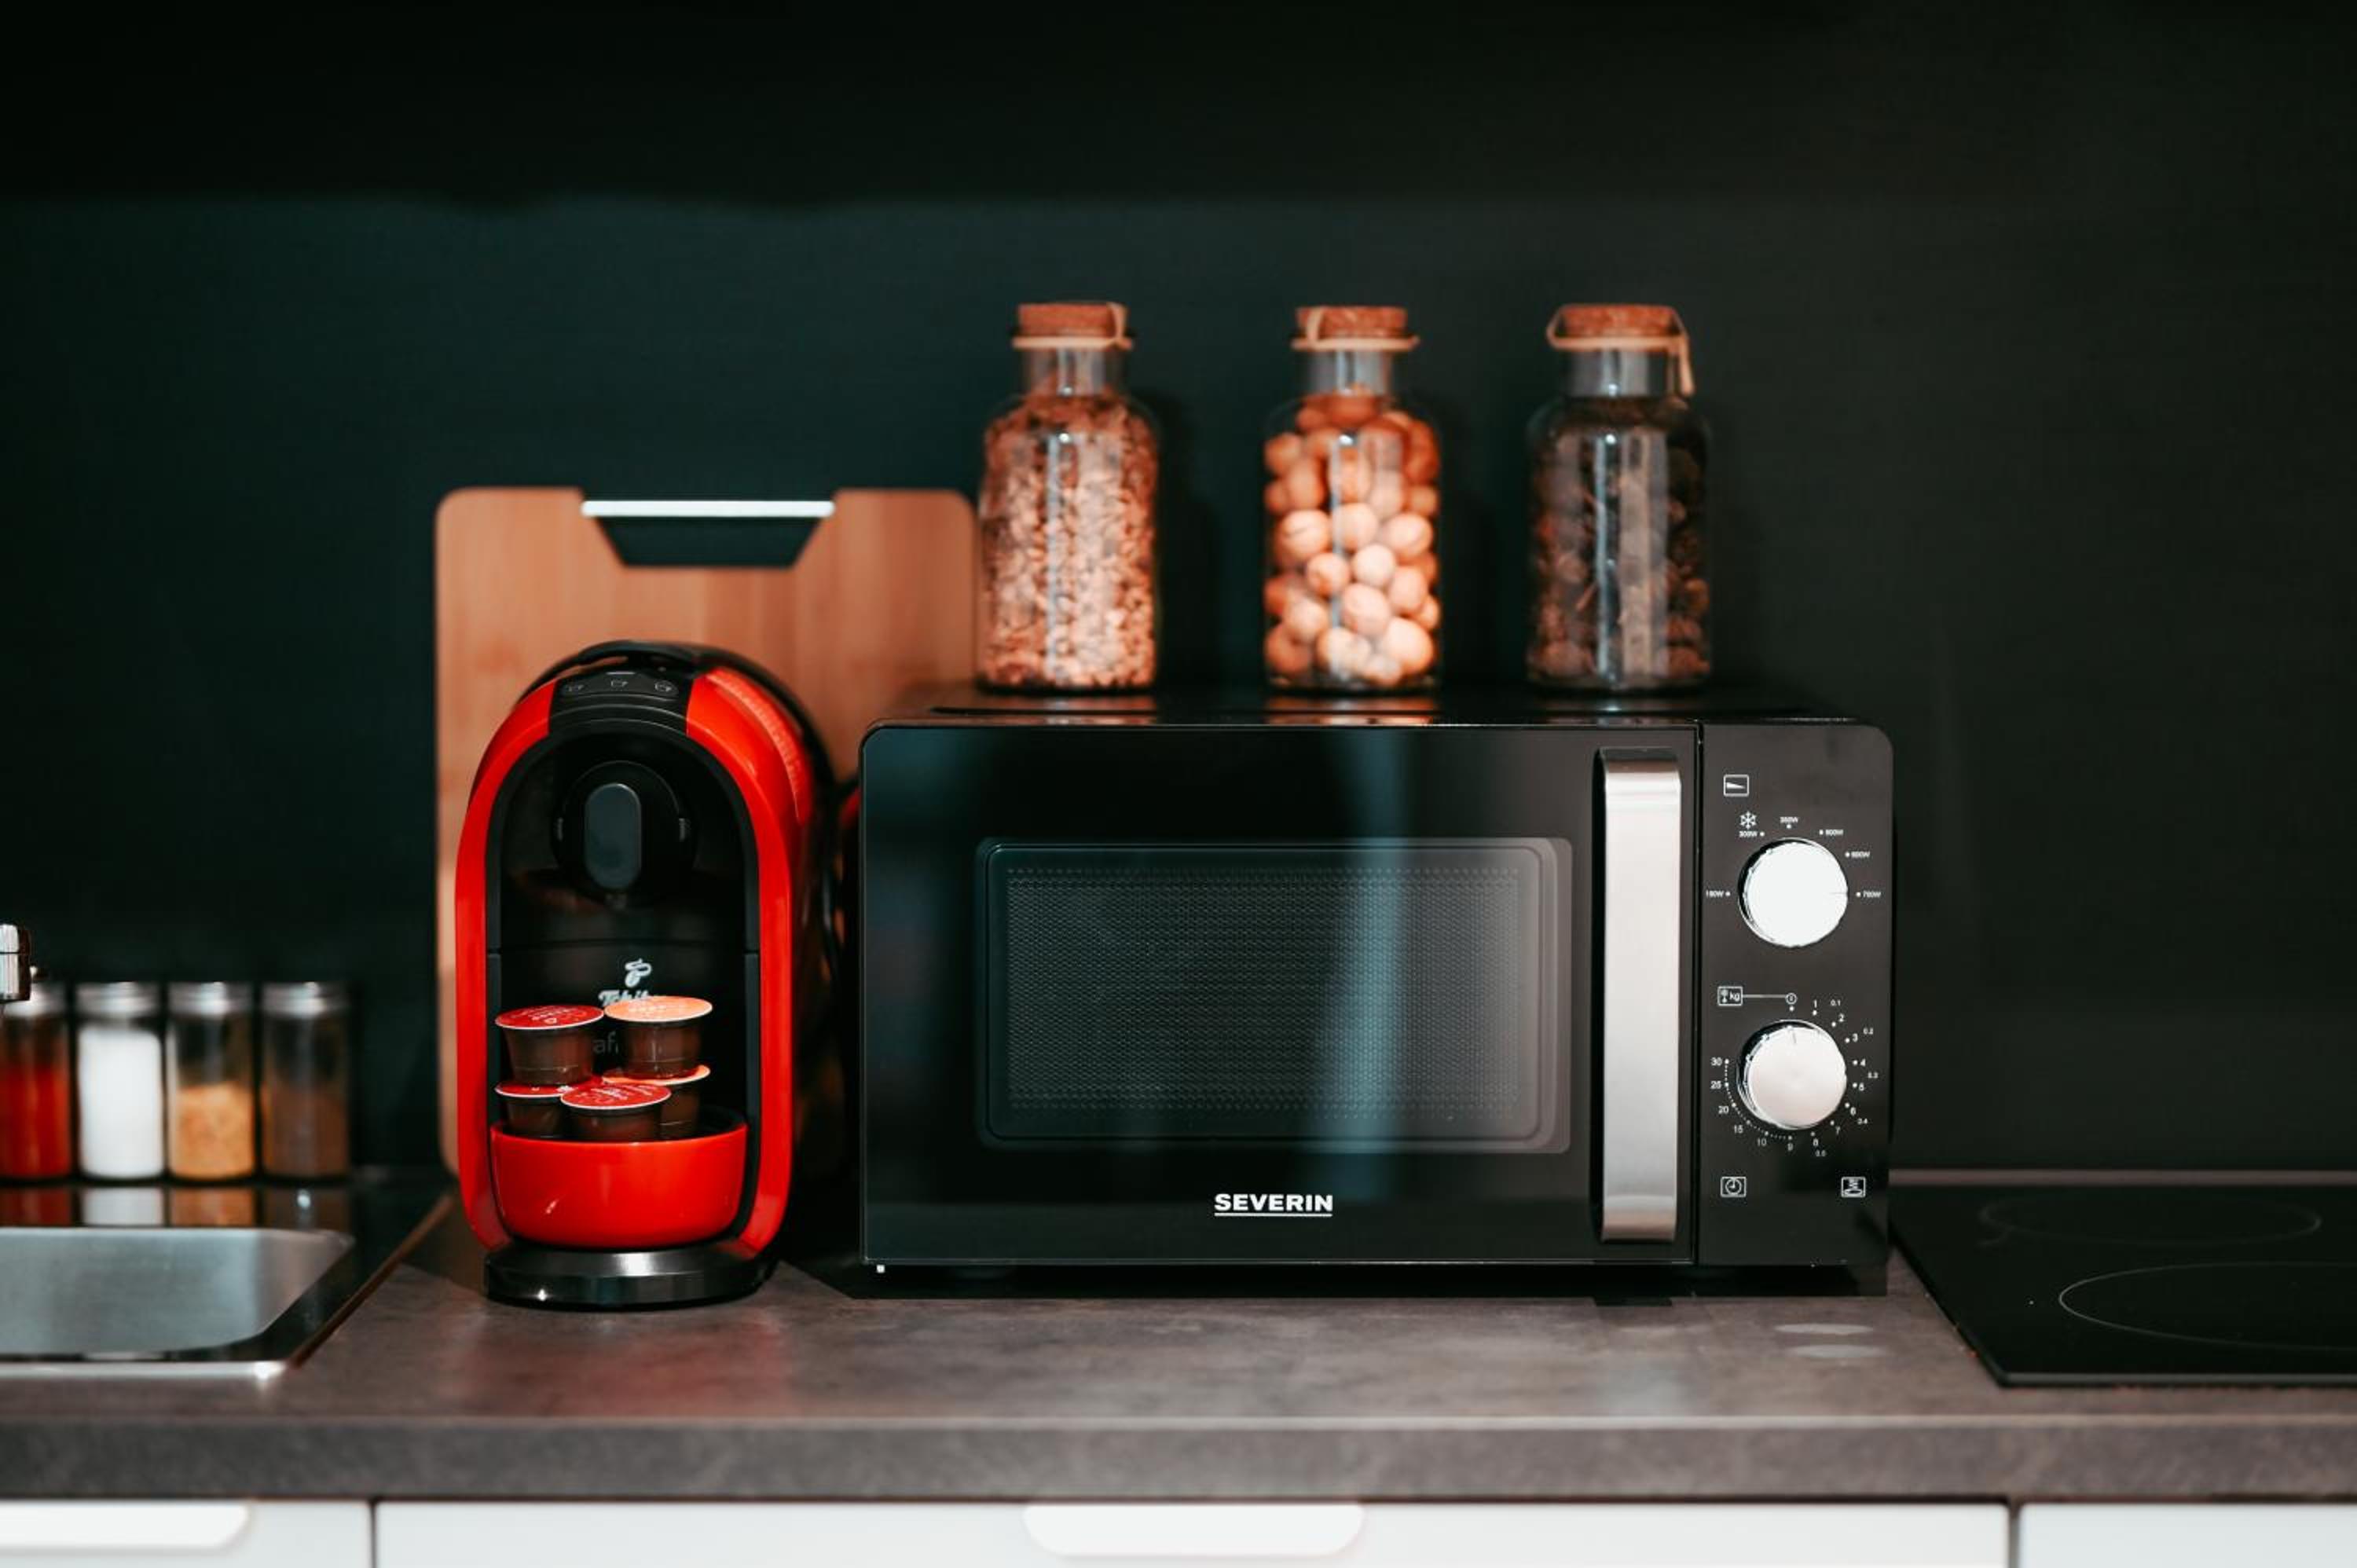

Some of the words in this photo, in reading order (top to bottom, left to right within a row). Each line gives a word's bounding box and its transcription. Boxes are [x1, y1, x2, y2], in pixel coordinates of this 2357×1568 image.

[1729, 990, 1740, 1002] kg
[1813, 999, 1817, 1009] 1
[1838, 1013, 1845, 1022] 2
[1852, 1033, 1858, 1042] 3
[1710, 1057, 1722, 1066] 30
[1718, 1105, 1729, 1114] 20
[1850, 1107, 1857, 1116] 6
[1734, 1125, 1743, 1134] 15
[1757, 1138, 1767, 1146] 10
[1787, 1143, 1794, 1152] 9
[1215, 1193, 1333, 1211] SEVERIN
